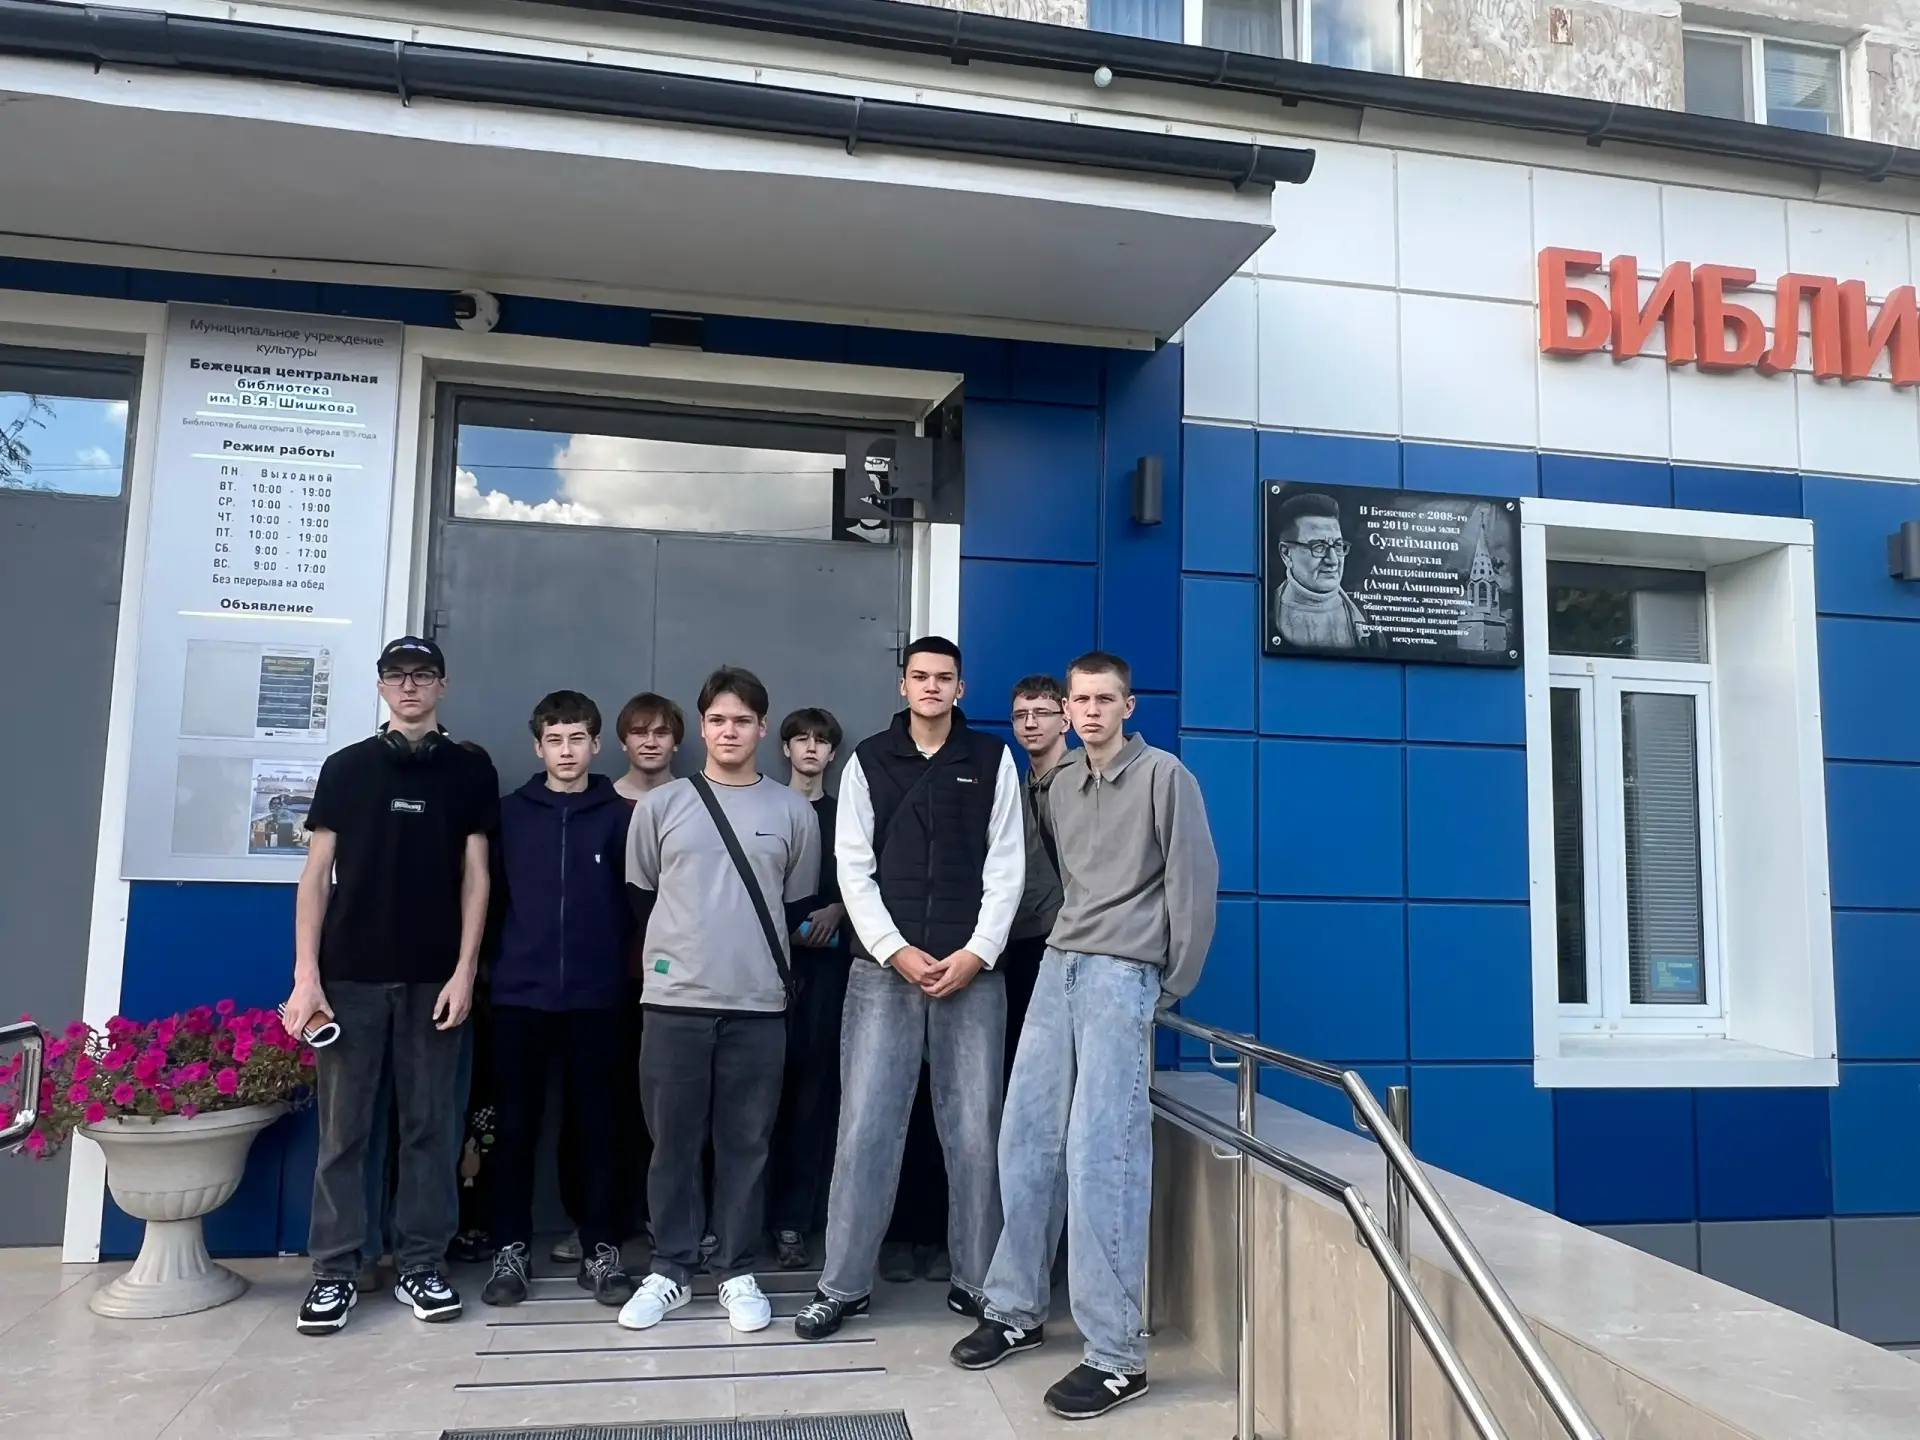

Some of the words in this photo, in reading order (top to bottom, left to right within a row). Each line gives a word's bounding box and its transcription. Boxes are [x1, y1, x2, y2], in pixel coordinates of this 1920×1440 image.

[1538, 246, 1920, 386] БИБЛИ
[190, 319, 300, 340] Муниципальное
[304, 331, 384, 346] учреждение
[256, 343, 317, 359] культуры
[190, 358, 271, 375] Бежецкая
[275, 366, 379, 384] центральная
[237, 378, 330, 395] библиотека
[209, 394, 236, 404] им.
[242, 394, 274, 407] В.Я.
[279, 397, 355, 414] Шишкова
[182, 417, 234, 429] Библиотека
[235, 420, 257, 430] была
[259, 424, 294, 434] открыта
[304, 427, 341, 437] февраля
[357, 432, 377, 440] года
[223, 440, 275, 454] Режим
[279, 444, 335, 458] работы
[220, 465, 243, 476] ПН.
[261, 468, 333, 482] Выходной
[220, 481, 236, 492] ВТ.
[252, 483, 282, 495] 10:00
[302, 487, 332, 498] 19:00
[218, 496, 236, 507] СР.
[251, 499, 281, 510] 10:00
[301, 502, 330, 513] 19:00
[217, 512, 235, 522] ЧТ.
[250, 514, 280, 525] 10:00
[300, 518, 329, 529] 19:00
[1359, 505, 1368, 515] В
[1371, 506, 1417, 519] Бежецке
[1427, 510, 1468, 523] 2008-го
[216, 527, 233, 538] ПТ.
[249, 529, 279, 540] 10:00
[299, 533, 328, 544] 19:00
[1367, 520, 1380, 529] по
[1382, 520, 1409, 531] 2019
[1411, 524, 1436, 533] годы
[1438, 526, 1461, 535] жил
[1369, 532, 1459, 551] Сулейманов
[214, 543, 231, 553] СБ.
[255, 545, 278, 556] 9:00
[298, 548, 327, 559] 17:00
[1386, 552, 1442, 566] Аманулла
[213, 558, 230, 569] ВС.
[253, 560, 277, 571] 9:00
[297, 564, 326, 575] 17:00
[1370, 565, 1459, 580] Аминджанович
[212, 573, 231, 585] Без
[234, 576, 283, 588] перерыва
[286, 580, 298, 588] на
[300, 579, 325, 590] обед
[1363, 578, 1400, 591] (Амон
[1402, 581, 1465, 597] Аминович)
[1353, 591, 1382, 603] Яркий
[220, 598, 314, 614] Объявление
[1363, 602, 1425, 613] общественный
[1426, 606, 1459, 615] деятель
[1370, 614, 1426, 624] талантливый
